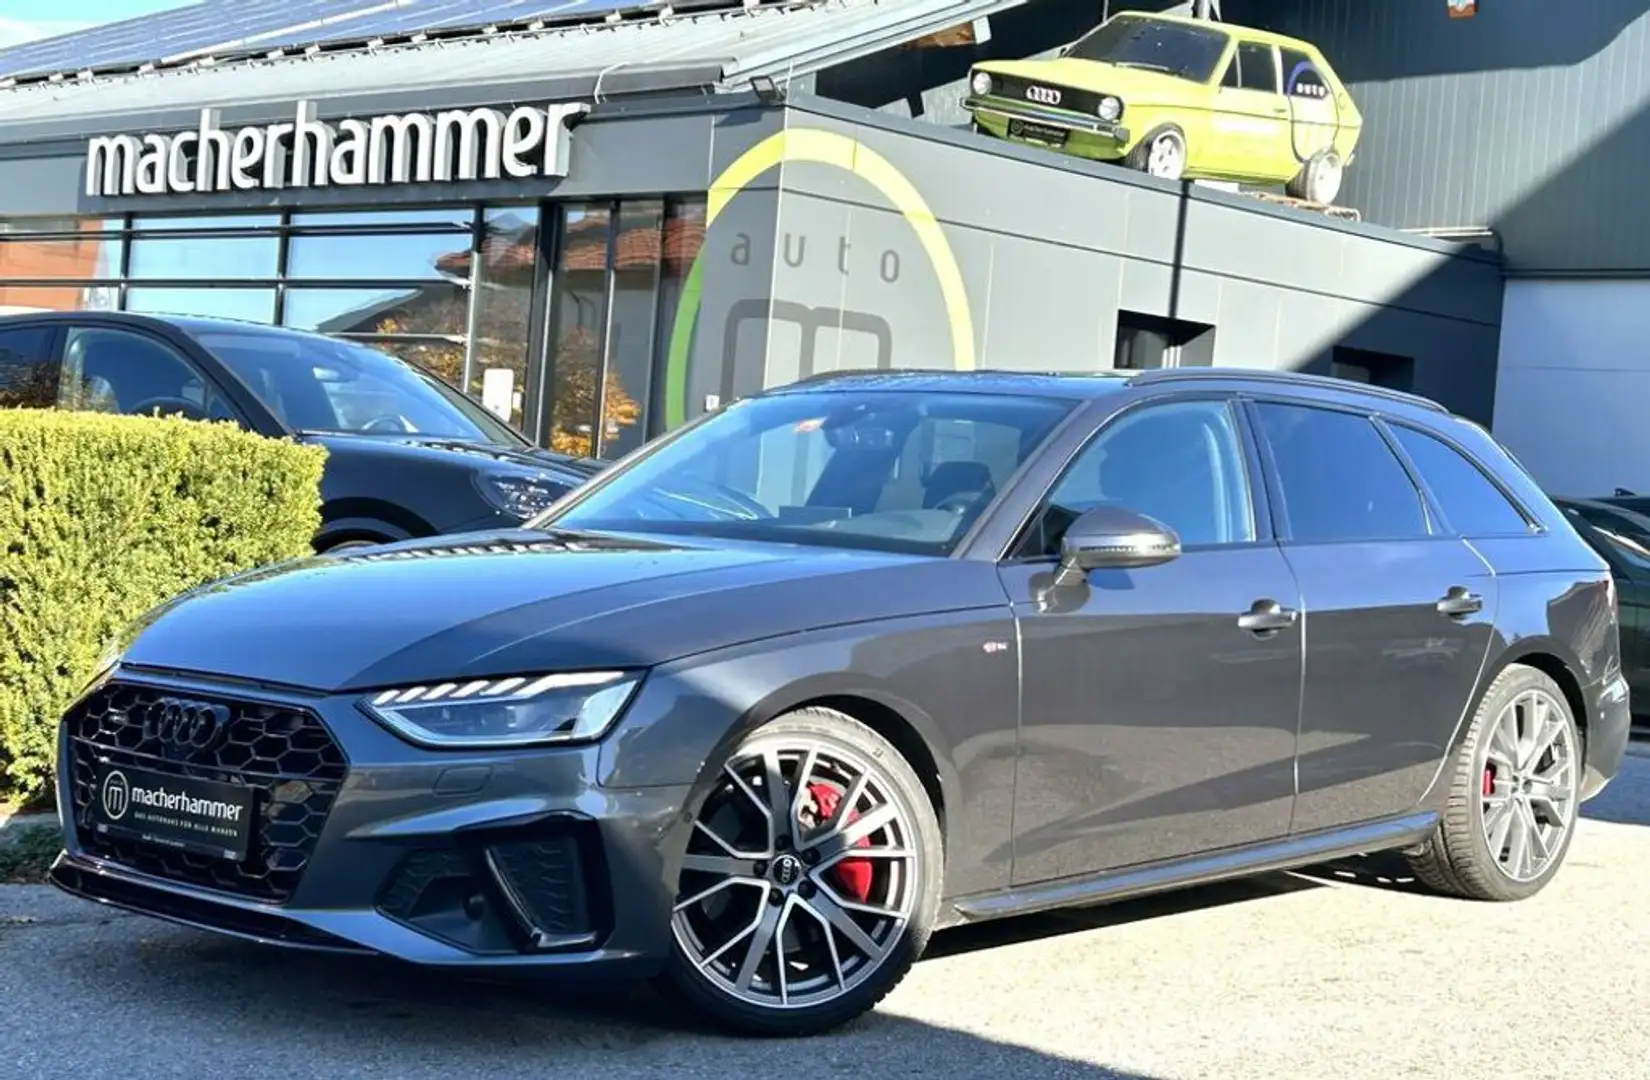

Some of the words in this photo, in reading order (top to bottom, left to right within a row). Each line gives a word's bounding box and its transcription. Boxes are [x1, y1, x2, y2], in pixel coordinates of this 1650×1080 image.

[85, 100, 590, 196] macherhammer
[730, 233, 900, 284] auto
[131, 786, 244, 822] macherhammer
